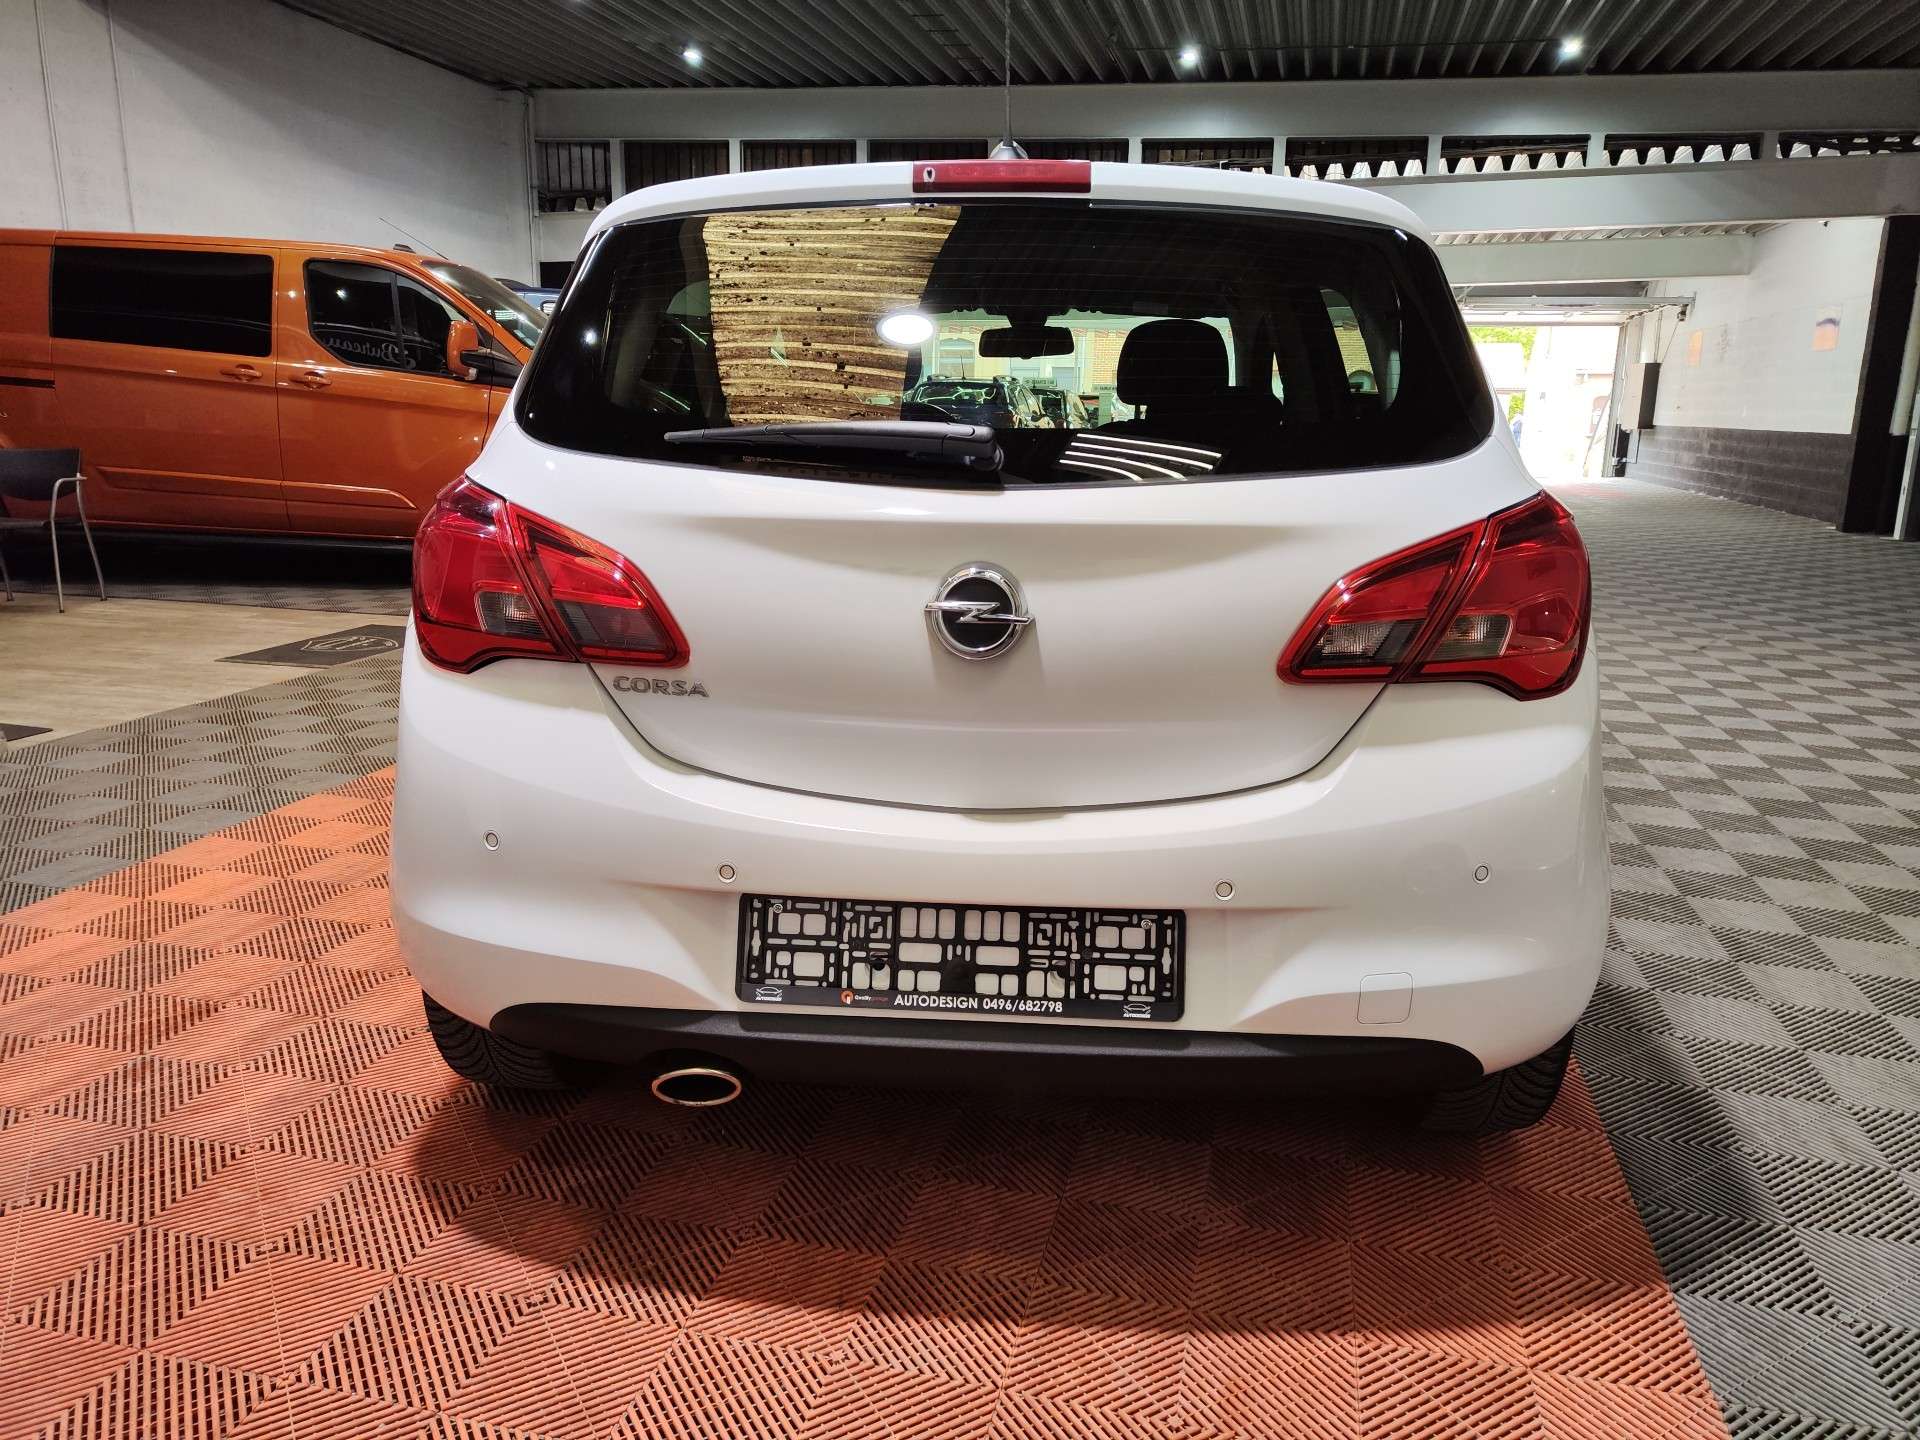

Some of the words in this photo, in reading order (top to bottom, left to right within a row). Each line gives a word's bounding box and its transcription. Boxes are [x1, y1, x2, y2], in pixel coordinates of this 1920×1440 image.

[613, 676, 709, 697] CORSA
[893, 994, 978, 1010] AUTODESIGN
[982, 997, 1063, 1014] 0496/682798
